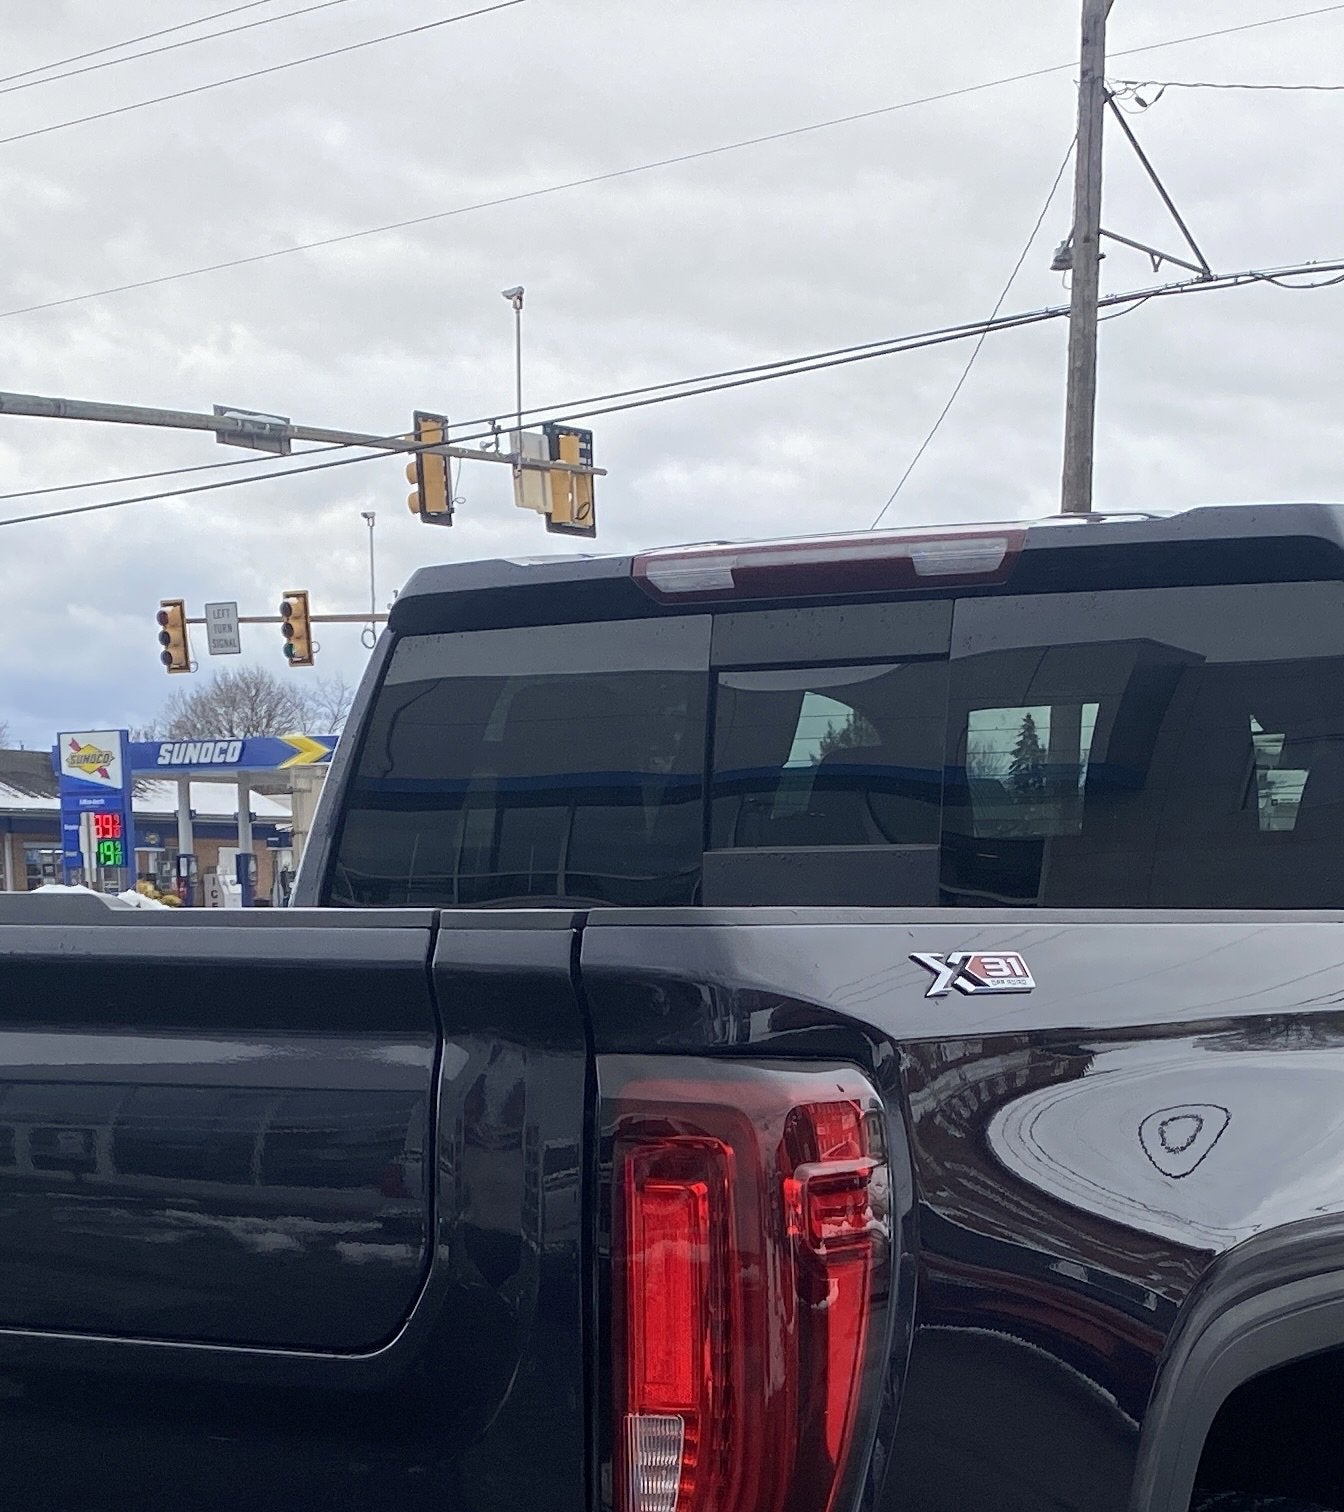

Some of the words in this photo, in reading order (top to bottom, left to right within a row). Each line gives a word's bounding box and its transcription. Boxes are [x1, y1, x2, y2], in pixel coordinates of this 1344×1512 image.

[212, 608, 231, 620] LEFT
[213, 623, 233, 634] TURN
[211, 638, 238, 649] SIGNAL
[69, 752, 112, 766] SUNOCO
[157, 741, 242, 765] SUNOCO
